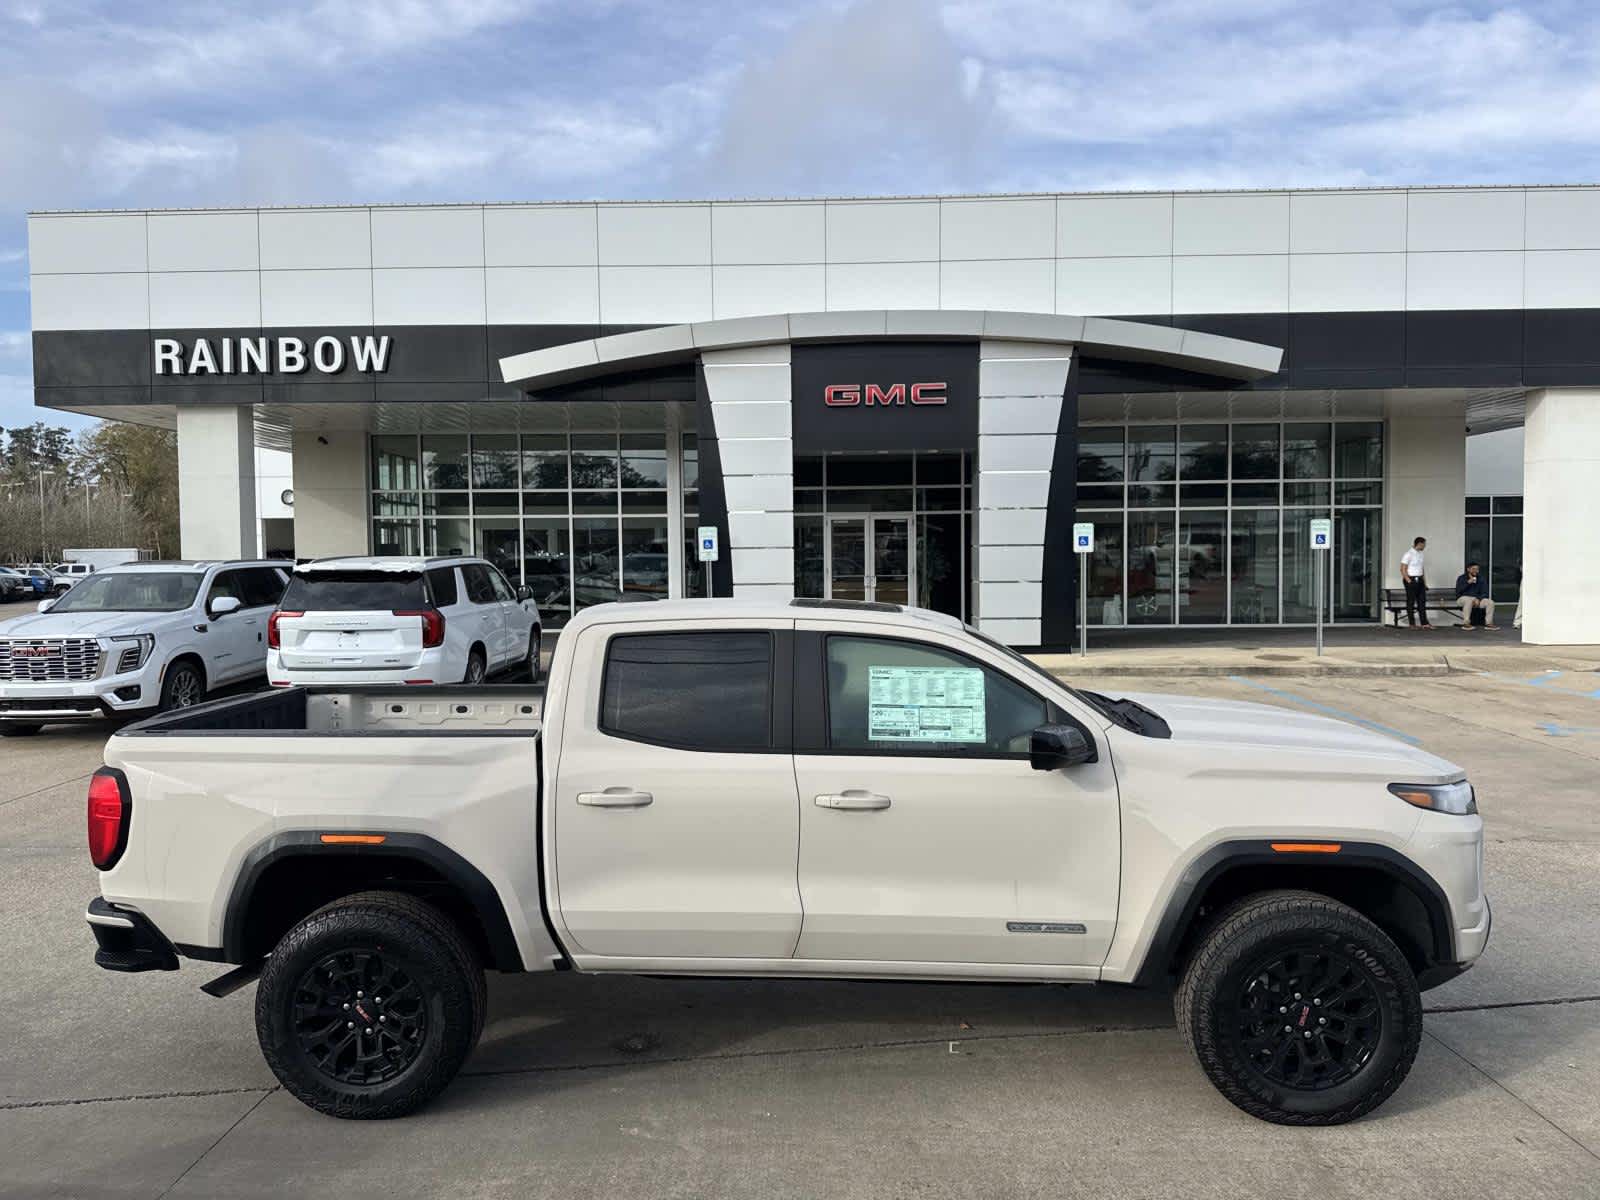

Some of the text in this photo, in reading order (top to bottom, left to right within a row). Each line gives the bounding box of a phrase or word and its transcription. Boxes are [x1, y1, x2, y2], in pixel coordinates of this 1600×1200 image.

[154, 336, 391, 375] RAINBOW
[825, 382, 948, 406] GMC
[12, 646, 60, 657] GMC
